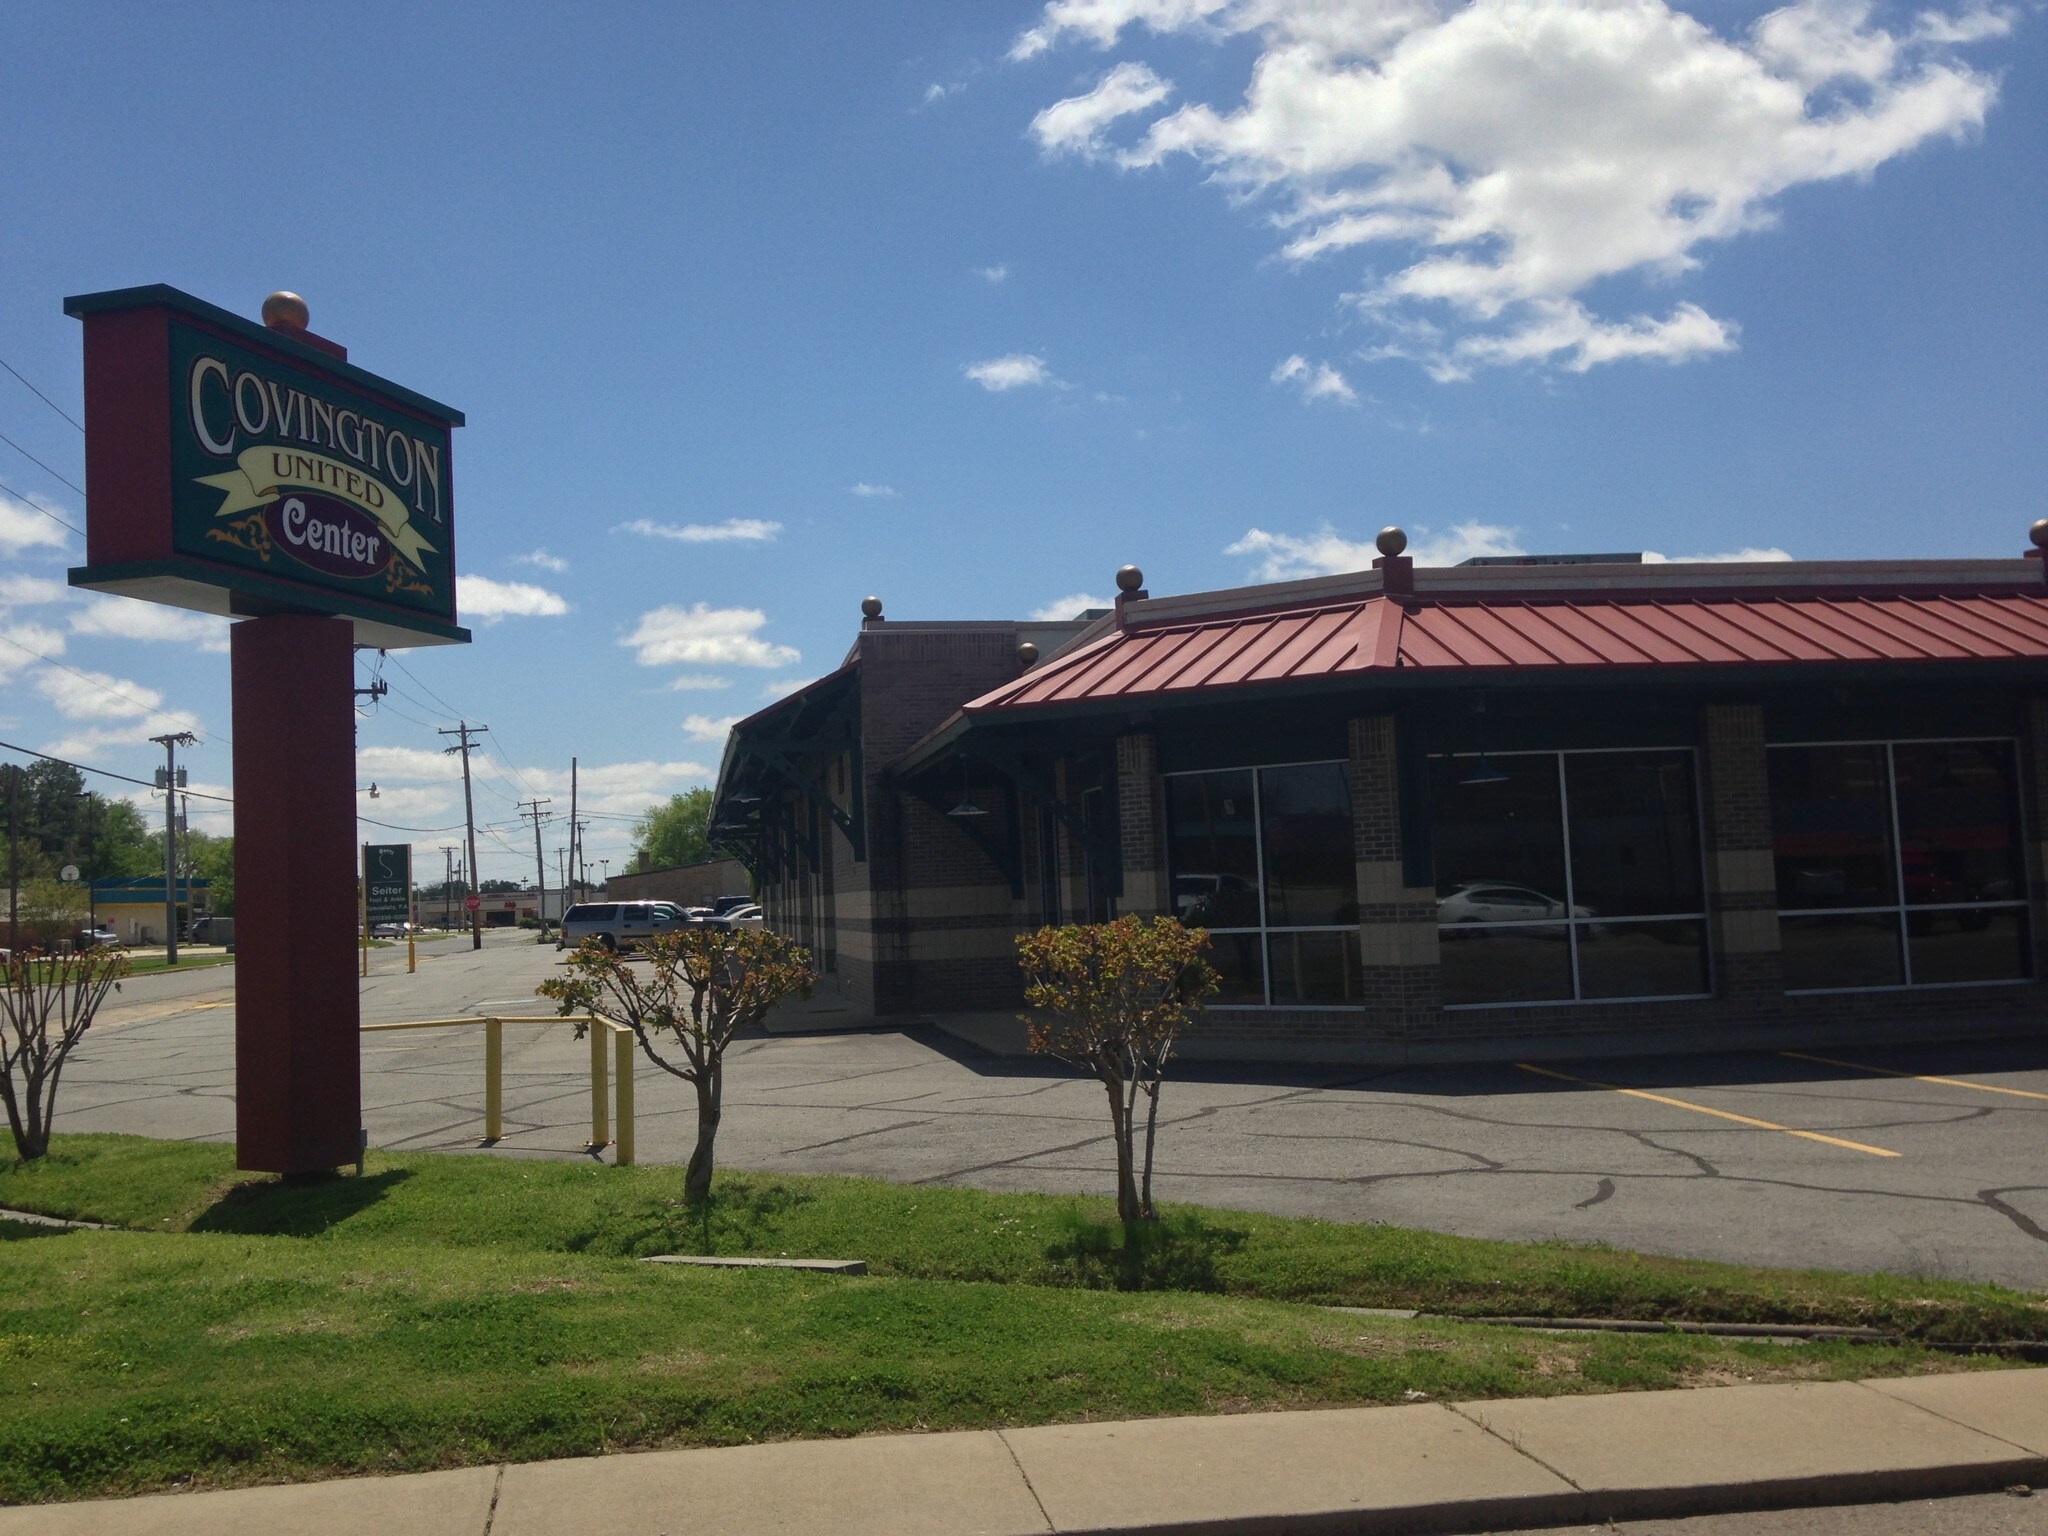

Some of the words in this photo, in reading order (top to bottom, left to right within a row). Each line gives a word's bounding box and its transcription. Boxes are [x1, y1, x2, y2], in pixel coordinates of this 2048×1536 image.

[190, 356, 442, 523] COVINGTON
[272, 452, 385, 509] UNITED
[282, 497, 380, 565] Center
[372, 886, 403, 896] Seiter
